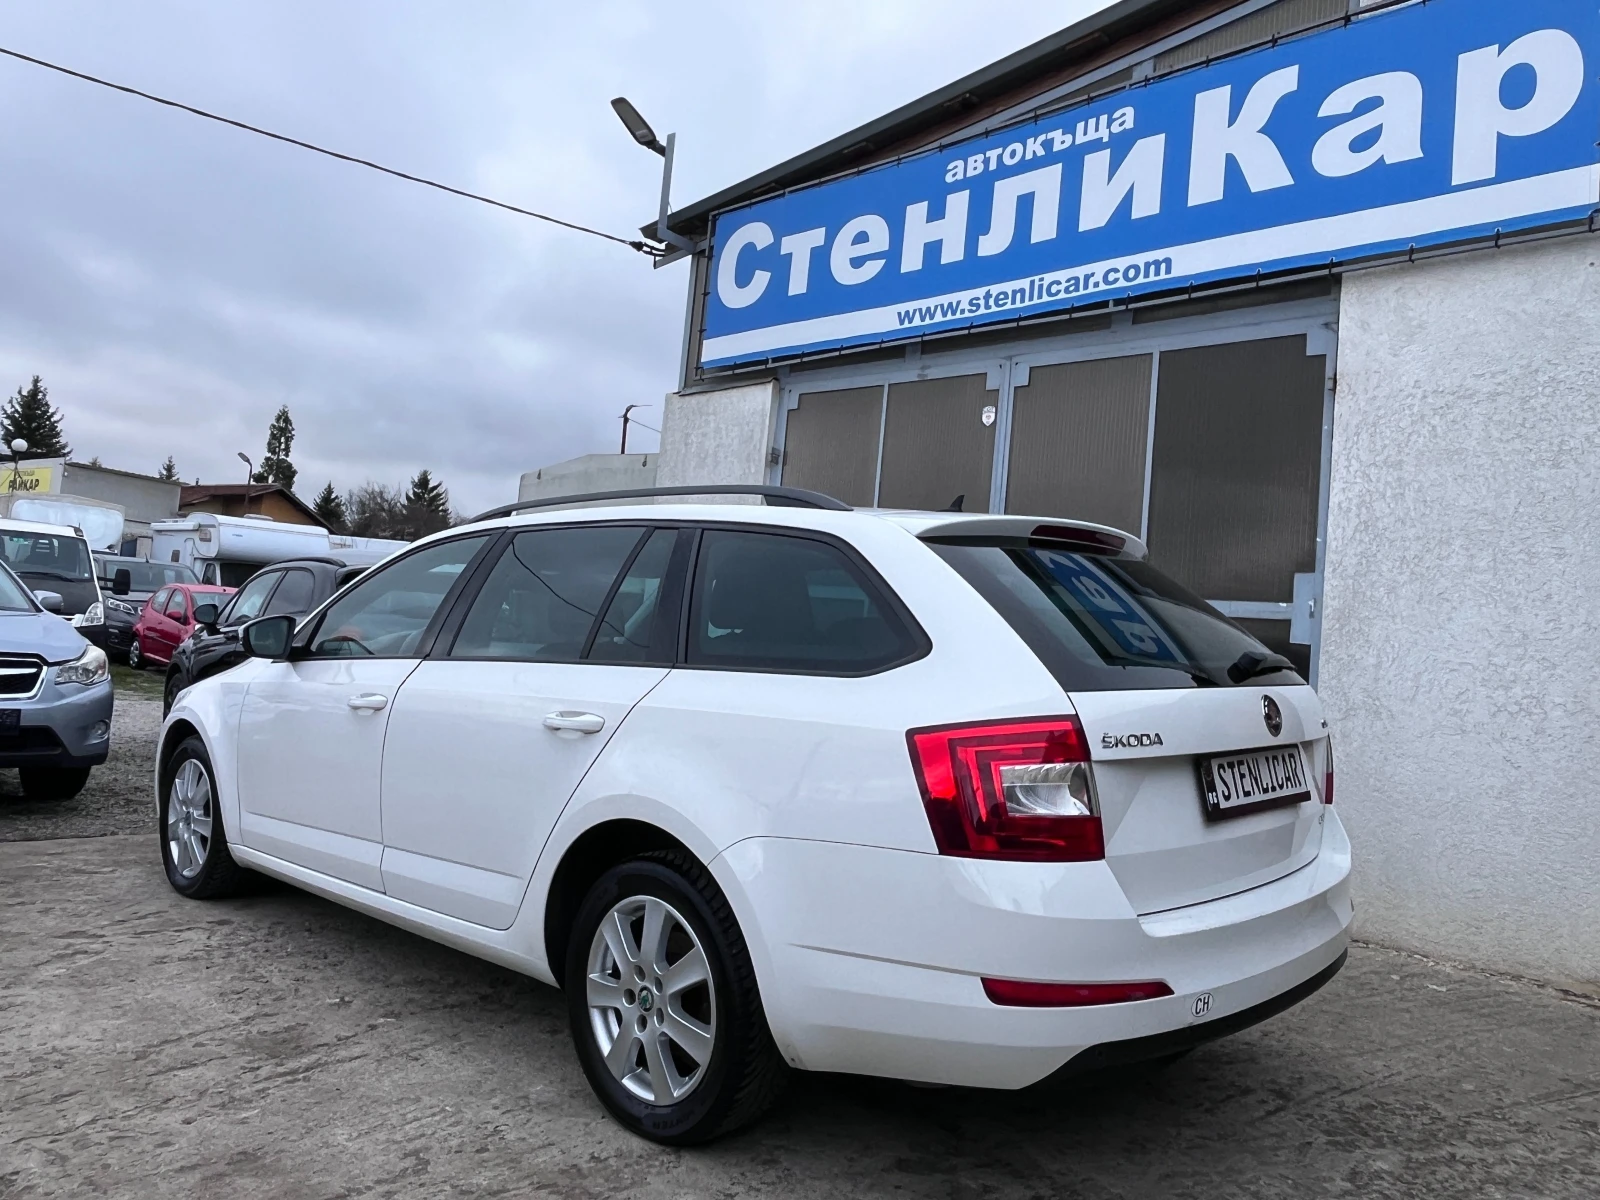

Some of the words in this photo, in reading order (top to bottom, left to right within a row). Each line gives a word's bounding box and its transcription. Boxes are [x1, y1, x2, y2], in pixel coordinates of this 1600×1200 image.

[717, 28, 1584, 309] СтенлиКар
[944, 106, 1135, 183] автокъща
[897, 256, 1172, 326] www.stenlicar.com
[1101, 732, 1164, 749] ŠKODA
[1217, 753, 1302, 802] STENLICAR
[1195, 994, 1210, 1015] CH
